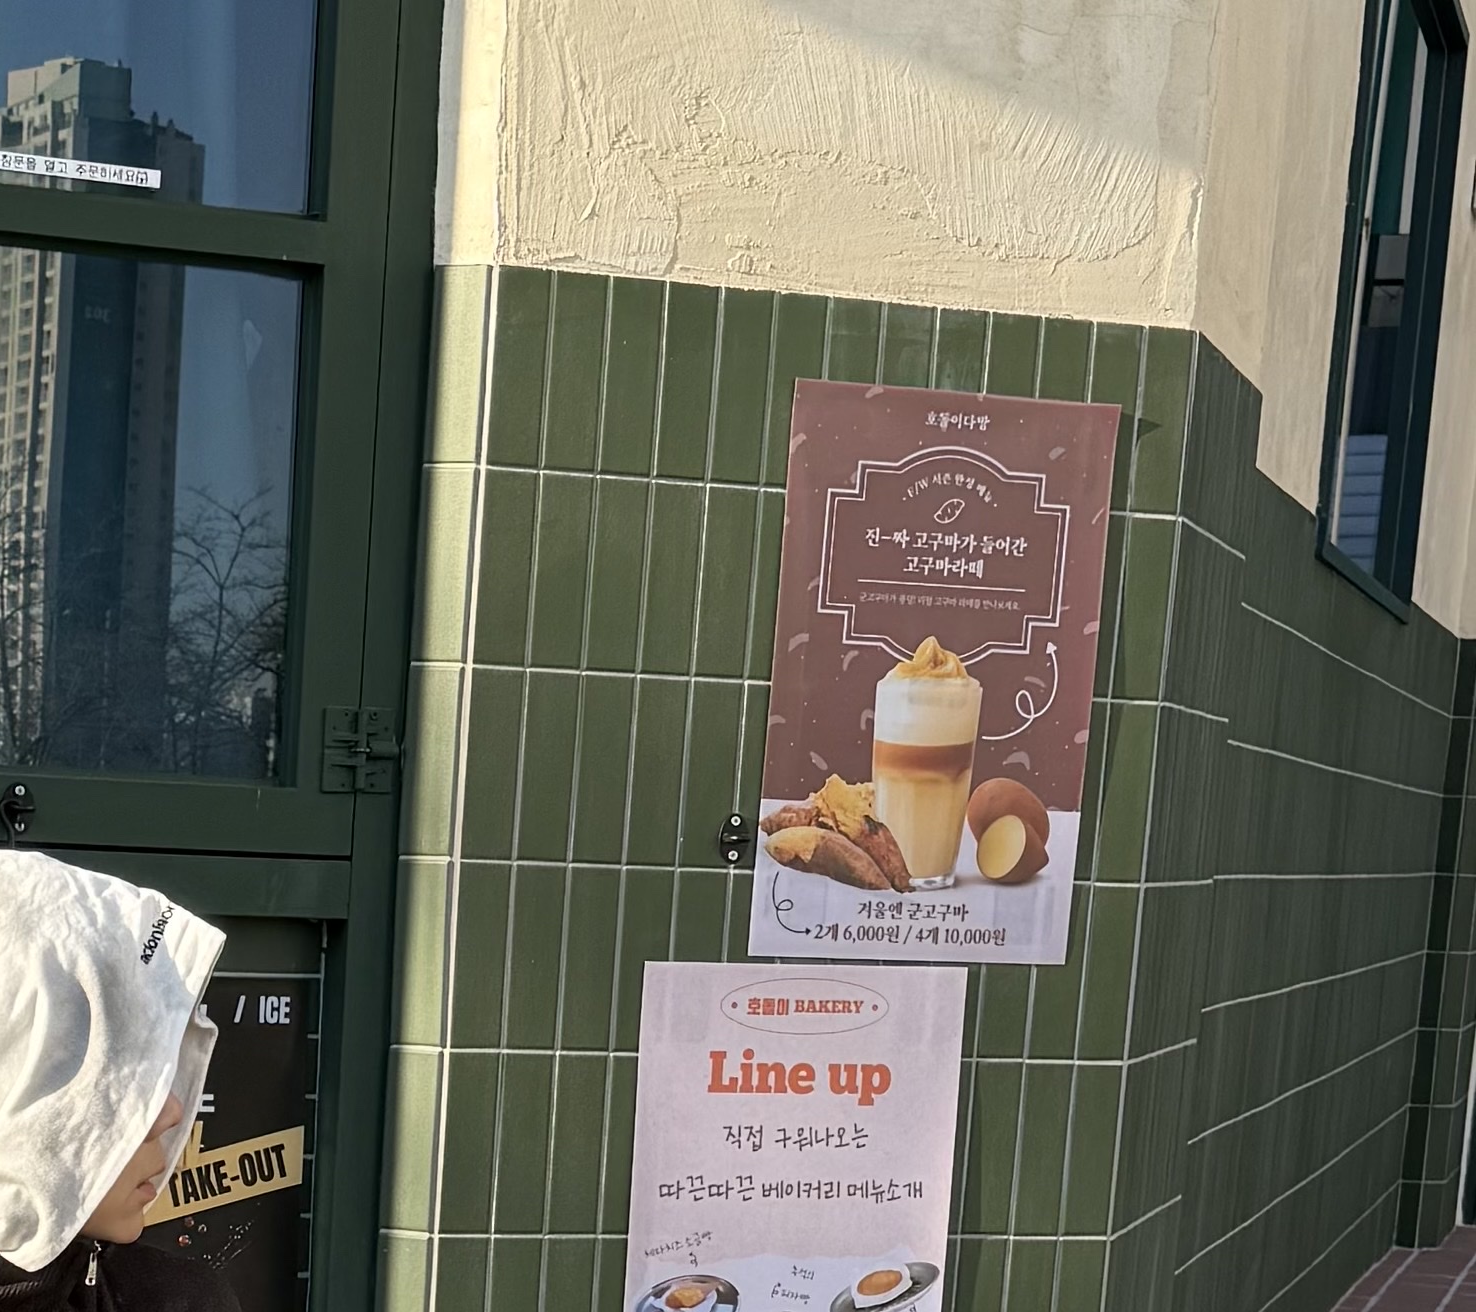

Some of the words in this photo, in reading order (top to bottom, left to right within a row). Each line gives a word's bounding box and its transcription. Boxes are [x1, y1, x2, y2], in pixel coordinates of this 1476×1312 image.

[0, 153, 37, 172] 창문을
[44, 159, 68, 174] 열고
[75, 163, 136, 183] 주문하세요
[907, 476, 929, 498] F/W
[932, 472, 951, 485] 시즌
[912, 532, 977, 554] 고구마가
[980, 534, 1028, 557] 들어간
[903, 554, 984, 579] 고구마라떼
[906, 902, 969, 921] 군고구마
[814, 924, 839, 942] 2개
[843, 925, 901, 944] 6,000원
[903, 926, 913, 945] /
[915, 926, 939, 945] 4개
[943, 927, 1006, 946] 10,000원
[259, 995, 291, 1025] ICE
[793, 998, 865, 1015] BAKERY
[707, 1048, 816, 1095] Line
[828, 1063, 893, 1107] up
[723, 1125, 764, 1152] 직접
[169, 1143, 288, 1208] TAKE-OUT
[659, 1175, 756, 1202] 따끈따끈
[761, 1179, 842, 1201] 베이커리
[847, 1178, 924, 1204] 메뉴소개
